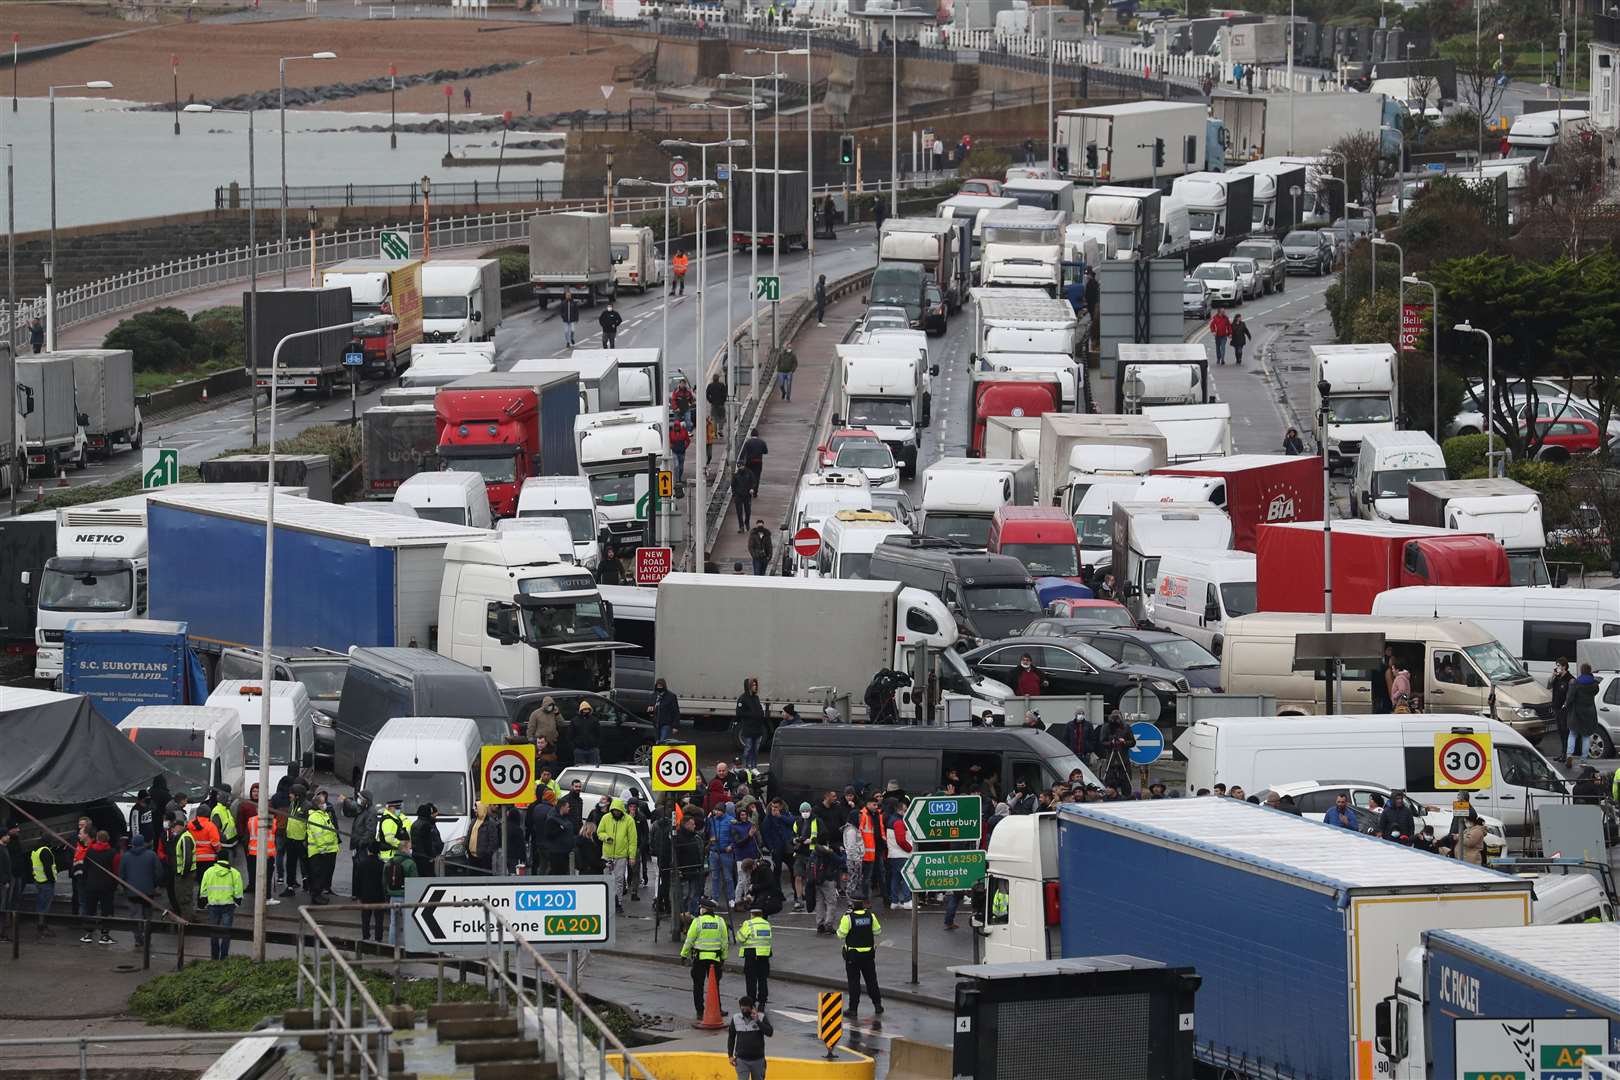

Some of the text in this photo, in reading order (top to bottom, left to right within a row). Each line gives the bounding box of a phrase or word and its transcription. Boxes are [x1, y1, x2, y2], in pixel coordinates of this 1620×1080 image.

[75, 534, 125, 543] NETKO
[643, 558, 665, 566] ROAD
[79, 661, 168, 672] S.C. EUROTRANS
[1446, 751, 1480, 771] 30
[492, 764, 524, 784] 30
[661, 760, 687, 777] 30
[930, 802, 955, 814] (M2)
[929, 818, 978, 828] Canterbury
[929, 828, 942, 837] A2
[925, 856, 945, 865] Deal
[925, 868, 968, 877] Ramsgate
[518, 893, 574, 910] (M20)
[547, 917, 599, 934] (A20)
[1439, 965, 1450, 1003] JC
[960, 1020, 967, 1029] 4
[1183, 1017, 1190, 1026] 4
[1378, 1061, 1389, 1073] 90
